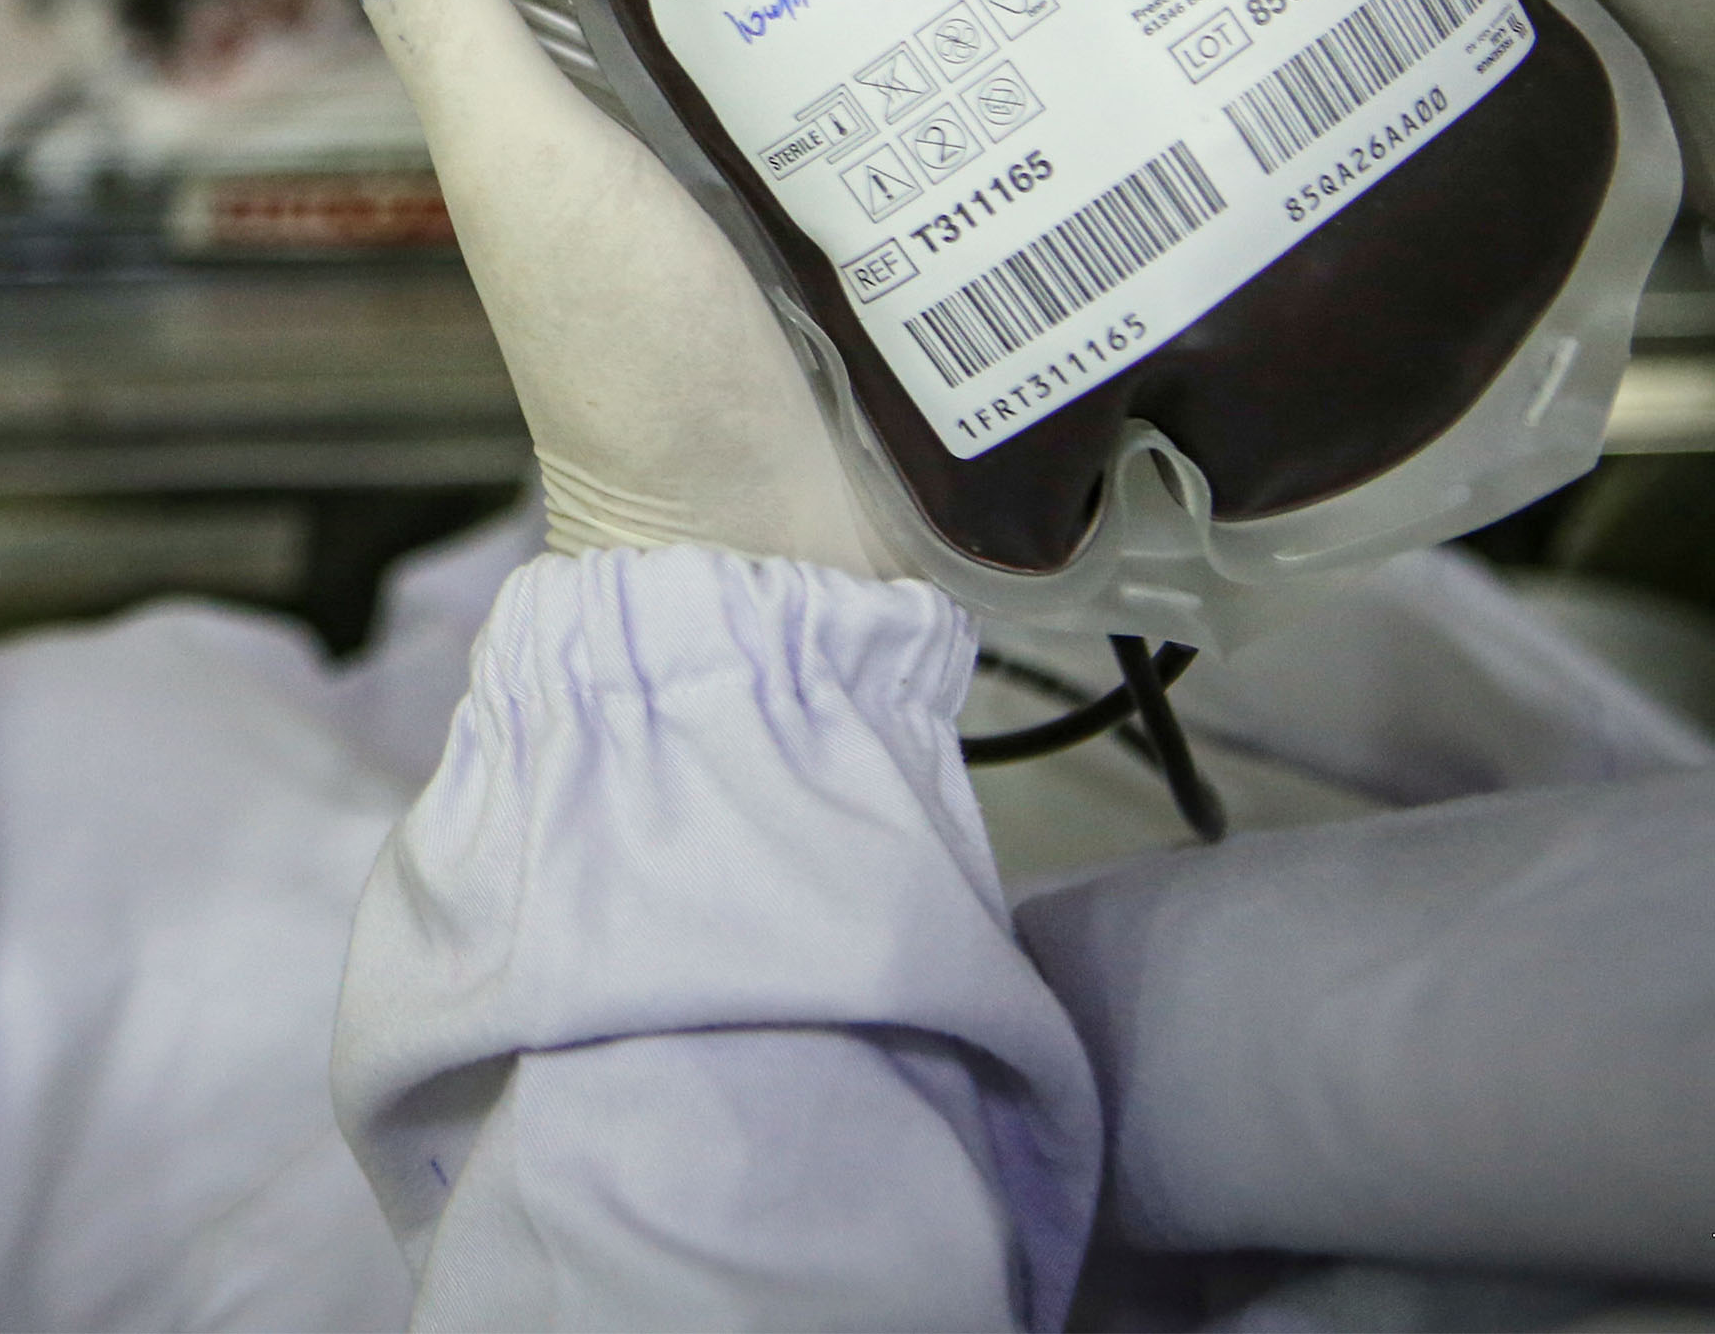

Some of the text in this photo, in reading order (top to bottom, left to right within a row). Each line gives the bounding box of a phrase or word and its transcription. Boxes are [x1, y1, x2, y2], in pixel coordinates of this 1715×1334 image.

[1141, 1, 1188, 37] 61346
[1182, 22, 1238, 70] LOT
[768, 128, 824, 173] STERILE
[1282, 85, 1451, 224] 85QA26AA00
[854, 148, 1057, 293] REF T311165
[955, 309, 1150, 444] 1FRT311165
